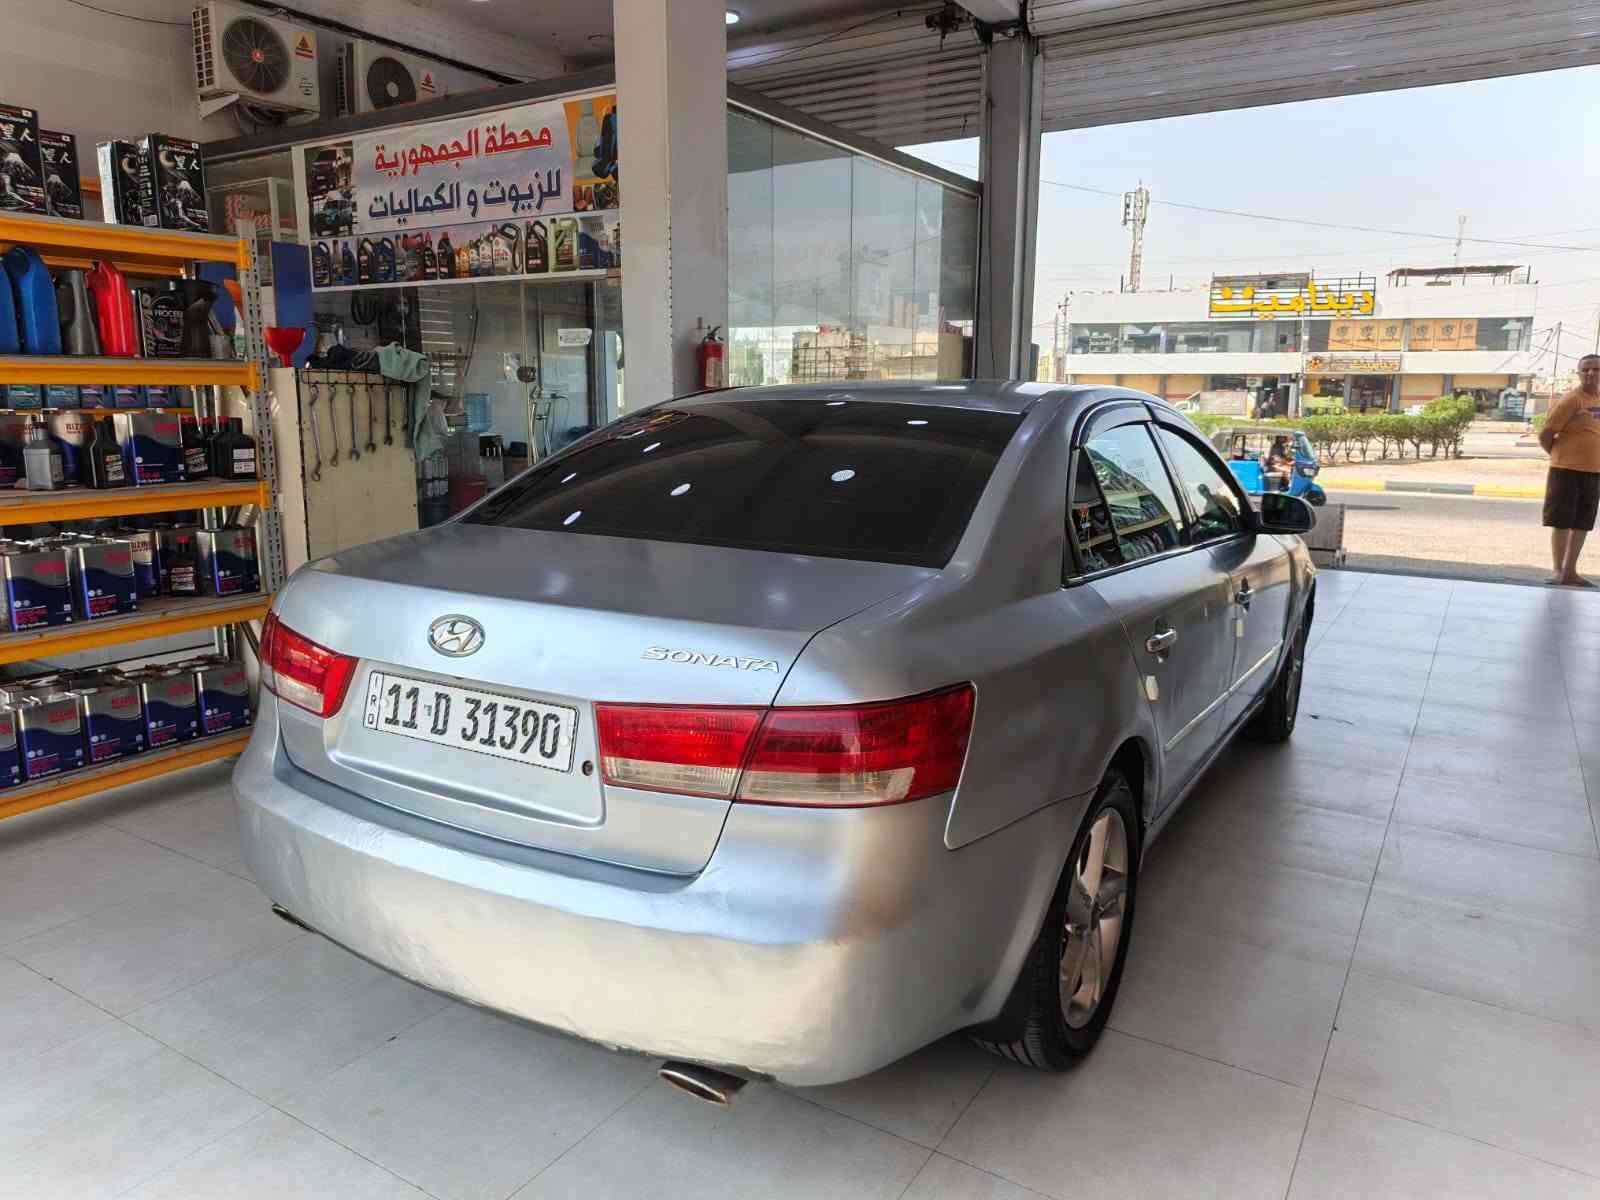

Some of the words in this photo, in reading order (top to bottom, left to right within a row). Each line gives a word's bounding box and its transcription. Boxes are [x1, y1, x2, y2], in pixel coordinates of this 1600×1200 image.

[375, 127, 480, 177] الجمهورية
[484, 122, 552, 155] محطة
[368, 181, 461, 225] الكماليات
[467, 188, 479, 218] و
[483, 168, 562, 214] للزيوت
[1211, 280, 1375, 320] ديناميت
[641, 646, 780, 673] SONATA
[384, 683, 420, 730] 11
[430, 690, 452, 736] D
[460, 697, 561, 760] 31390
